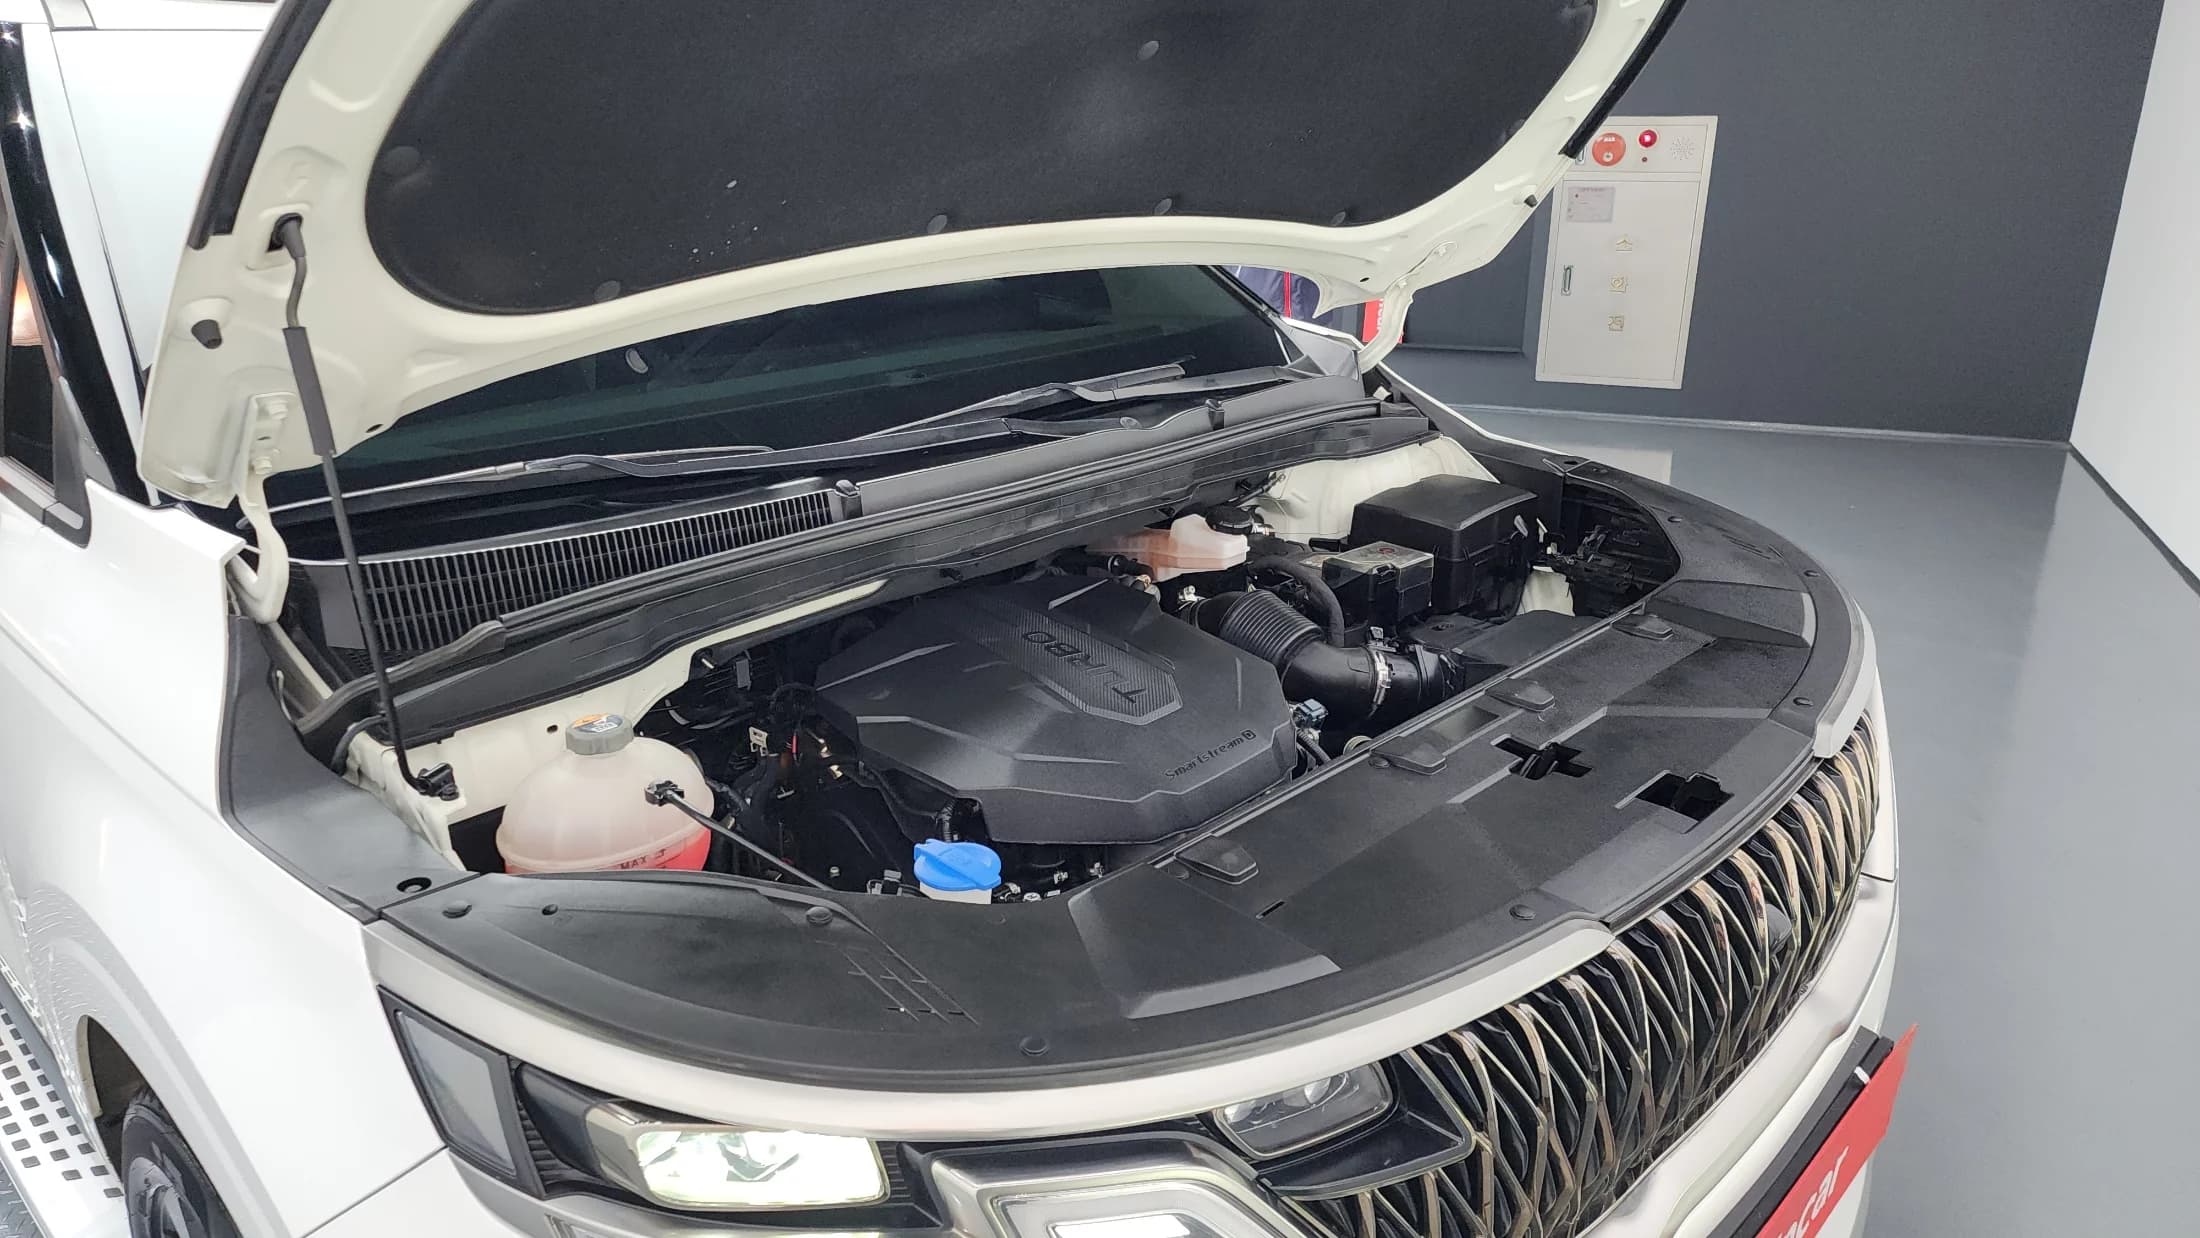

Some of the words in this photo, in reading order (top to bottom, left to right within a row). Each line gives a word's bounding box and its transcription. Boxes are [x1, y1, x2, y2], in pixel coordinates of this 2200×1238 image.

[1022, 629, 1147, 705] TURBO
[1164, 735, 1244, 780] Smartstream
[620, 854, 649, 870] MAX
